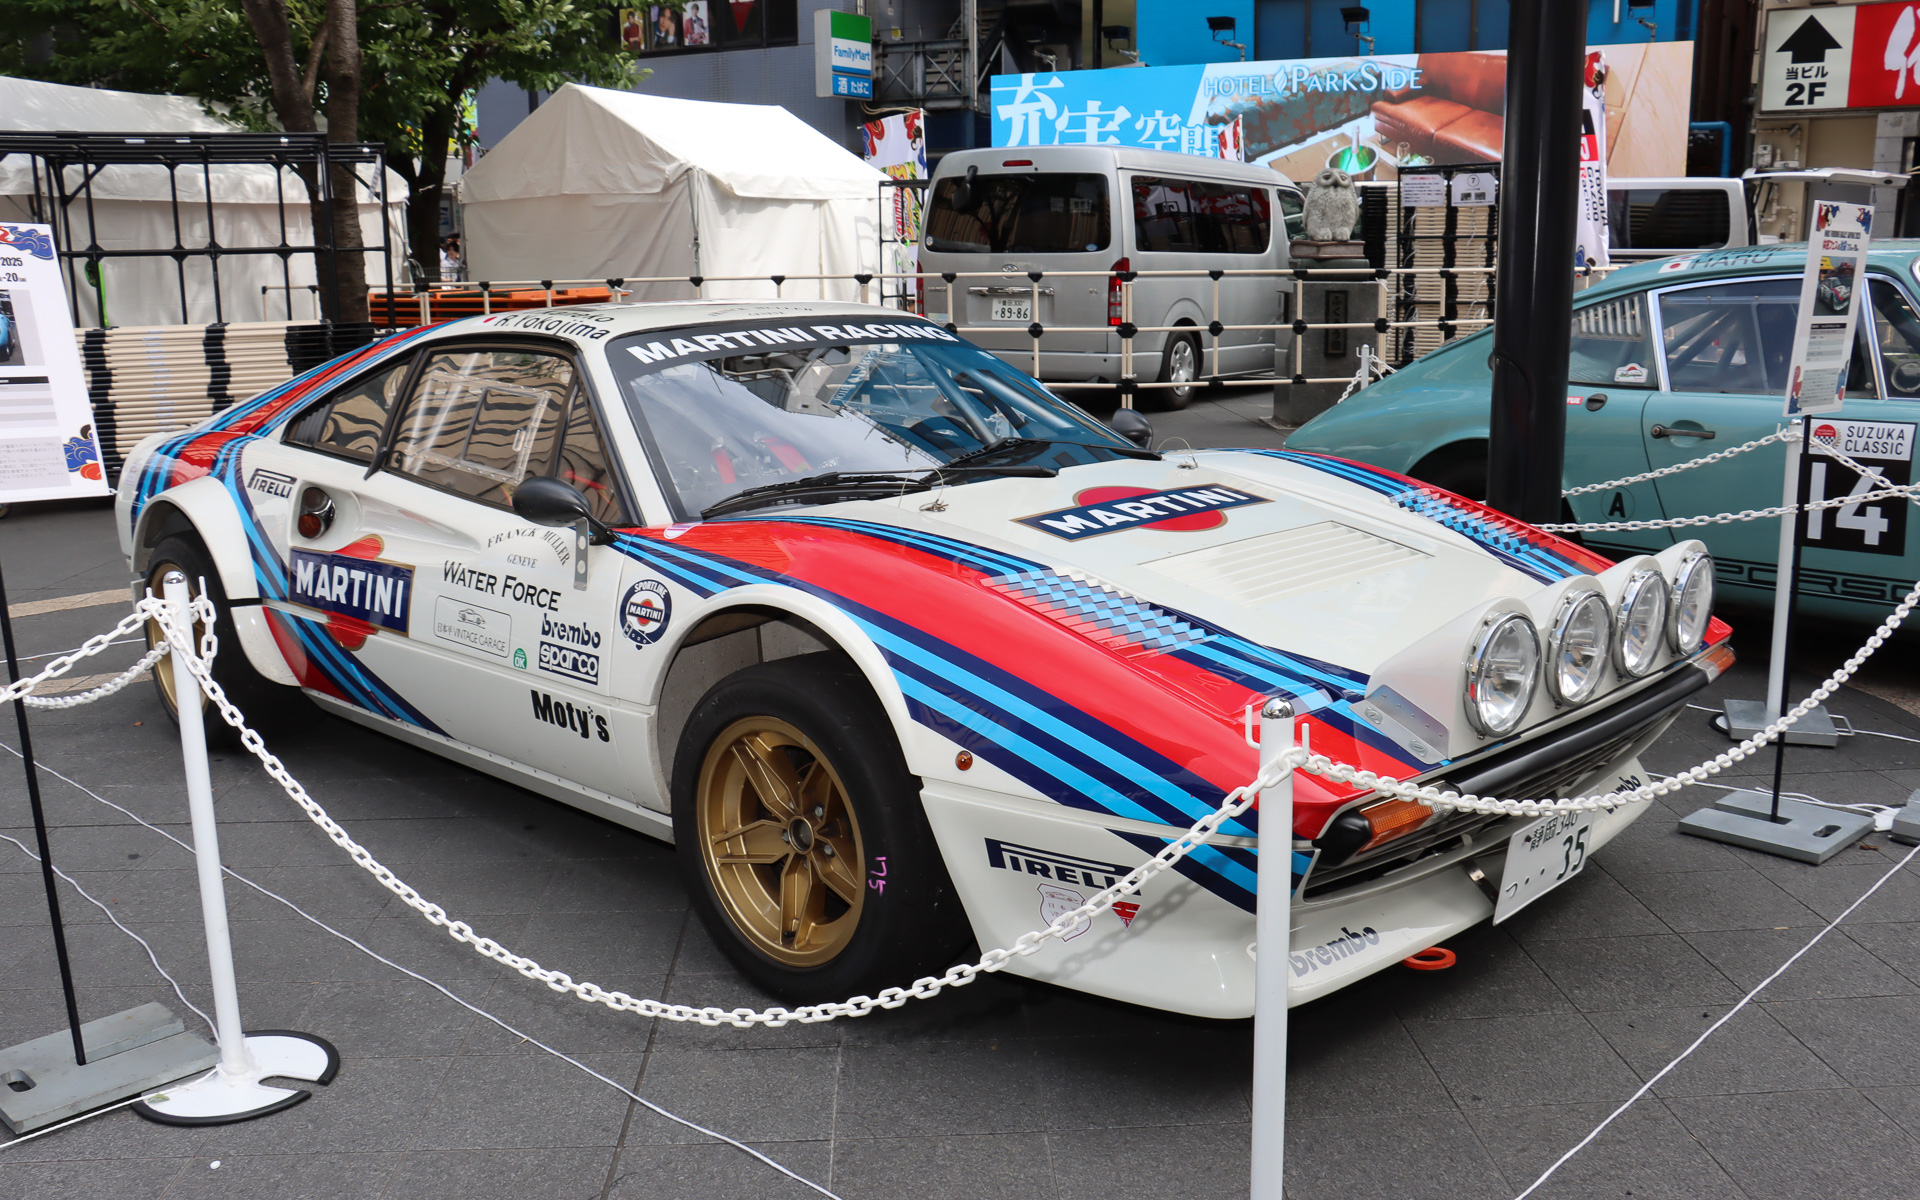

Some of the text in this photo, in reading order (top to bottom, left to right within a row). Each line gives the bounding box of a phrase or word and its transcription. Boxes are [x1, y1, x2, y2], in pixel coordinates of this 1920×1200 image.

[833, 45, 871, 61] FamilyMart
[838, 77, 870, 94] 酒 たばこ
[1786, 65, 1829, 81] 当ビル
[1204, 77, 1272, 97] HOTEL
[1784, 82, 1828, 107] 2F
[1587, 166, 1599, 222] GAZOO
[1691, 253, 1773, 270] HARU
[1000, 307, 1029, 319] 89-86
[626, 323, 960, 365] MARTINI RACING
[1847, 425, 1905, 441] SUZUKA
[1845, 439, 1904, 456] CLASSIC
[247, 467, 298, 499] PIRELLI
[1040, 487, 1250, 534] MARTINI
[1608, 491, 1627, 519] A
[1807, 461, 1889, 546] 14
[487, 527, 571, 567] FRANCK MULLER
[506, 553, 538, 569] GENEVE
[296, 559, 405, 618] MARTINI
[634, 580, 668, 599] SPORTLINE
[629, 604, 662, 620] MARTINI
[453, 627, 479, 645] VINTAGE
[478, 634, 506, 653] GARAGE
[541, 613, 601, 649] brembo
[514, 657, 526, 669] OK
[540, 642, 598, 678] sparco
[530, 689, 610, 743] Moty's
[1530, 817, 1558, 852] 静岡
[1288, 926, 1380, 978] brembo
